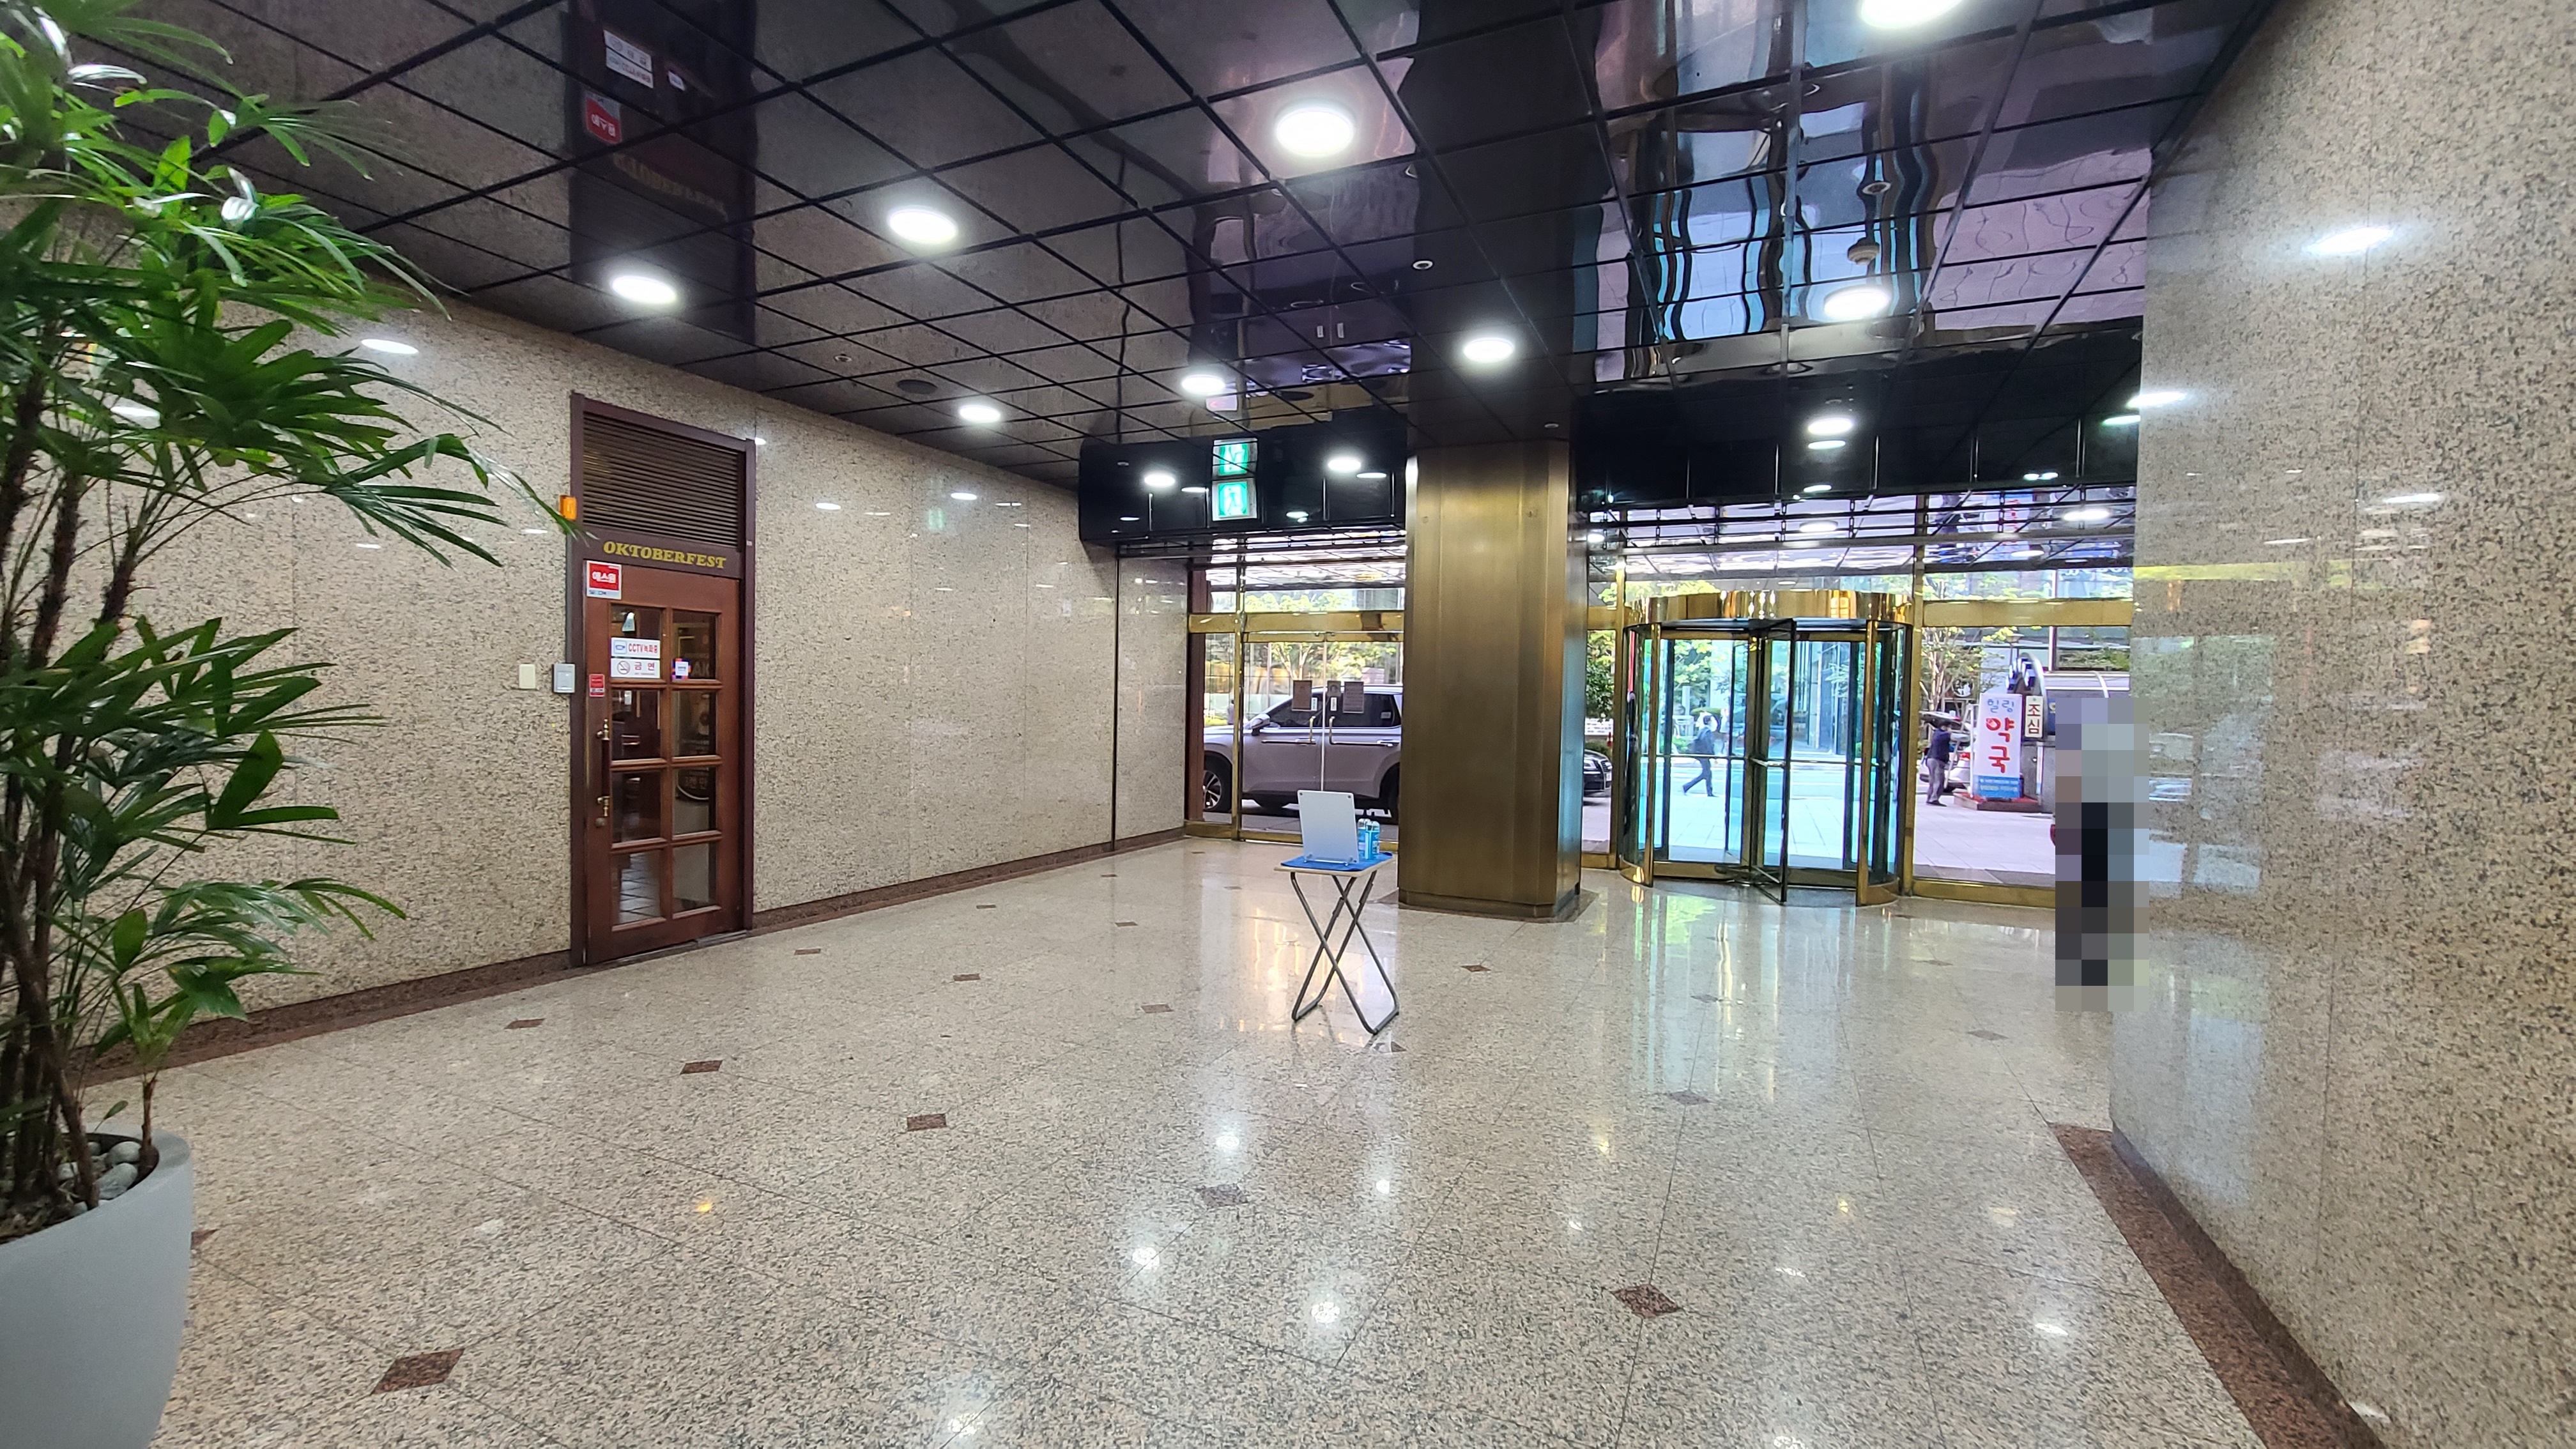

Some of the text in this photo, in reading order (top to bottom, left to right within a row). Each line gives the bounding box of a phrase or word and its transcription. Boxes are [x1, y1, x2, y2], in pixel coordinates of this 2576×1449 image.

[603, 541, 726, 569] OKTOBERFEST
[1987, 698, 2014, 714] 힐링
[2027, 703, 2041, 734] 조심
[1985, 717, 2015, 774] 약국
